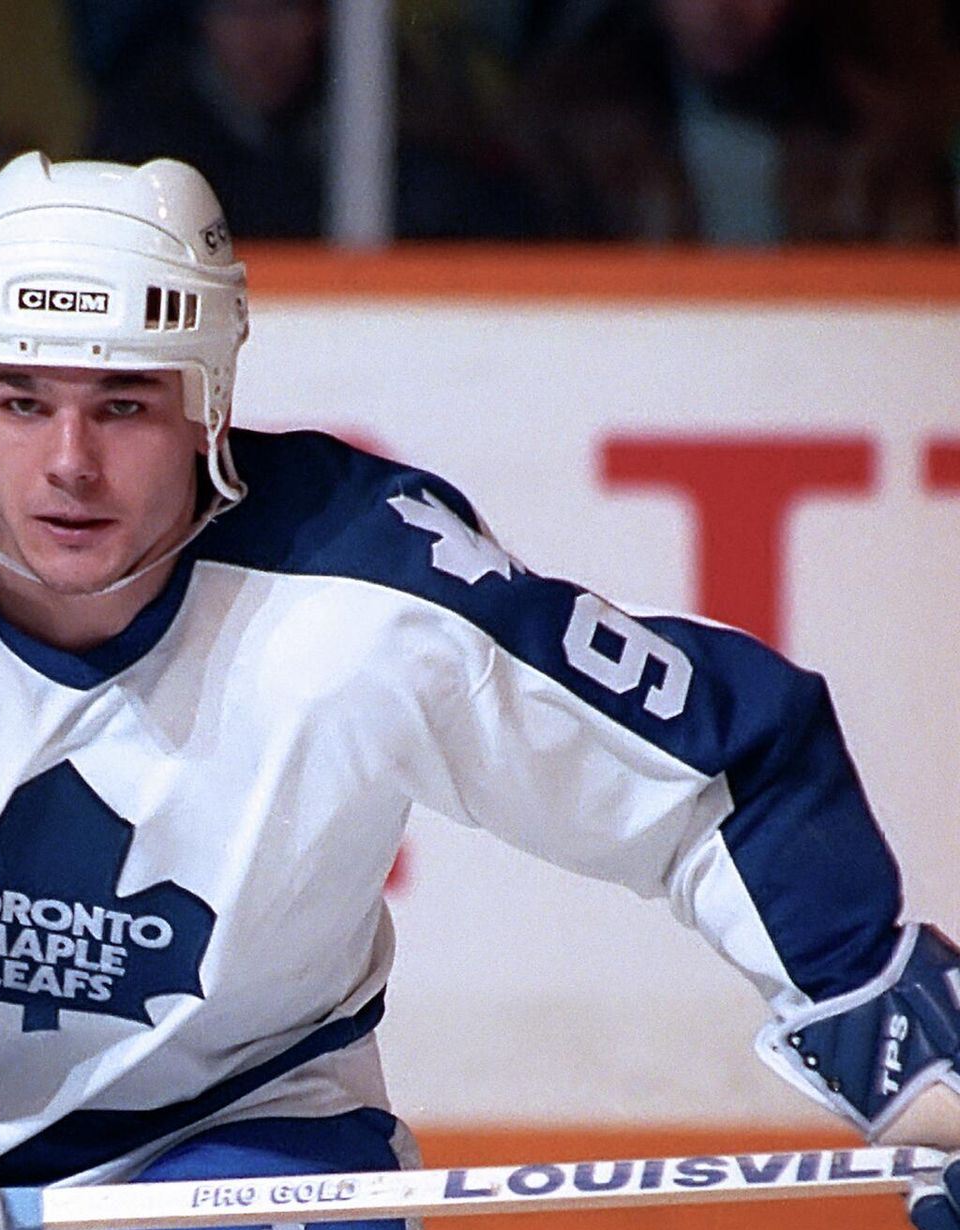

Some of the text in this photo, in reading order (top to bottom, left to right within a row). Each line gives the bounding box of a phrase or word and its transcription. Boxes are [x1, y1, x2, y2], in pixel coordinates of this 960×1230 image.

[20, 289, 107, 313] CCM
[562, 593, 693, 720] 9
[883, 1014, 909, 1095] TPS
[191, 1185, 256, 1208] PRO
[270, 1178, 358, 1204] GOLD
